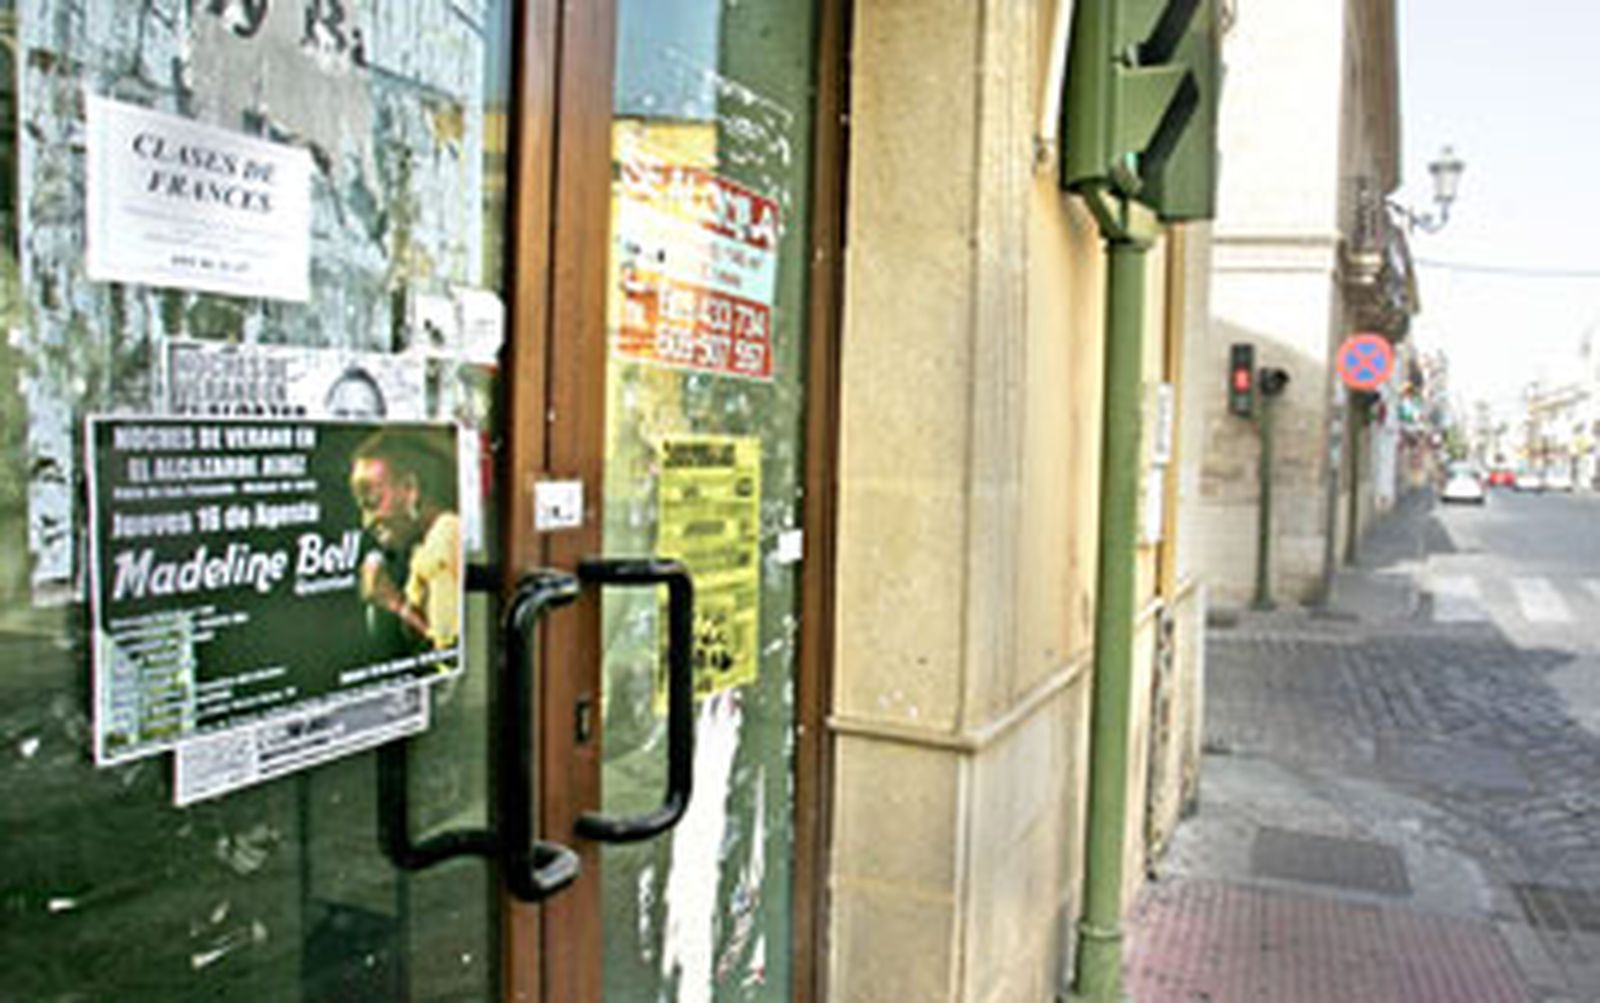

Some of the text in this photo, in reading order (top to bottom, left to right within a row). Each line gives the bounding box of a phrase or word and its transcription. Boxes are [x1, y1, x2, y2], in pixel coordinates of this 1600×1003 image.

[132, 132, 237, 175] CLASES
[147, 169, 272, 214] FRANCES
[199, 426, 221, 449] DE
[112, 511, 193, 538] Jueves
[224, 503, 250, 531] de
[254, 500, 321, 530] Agosto
[112, 543, 288, 601] Madeline
[295, 530, 362, 576] Bell
